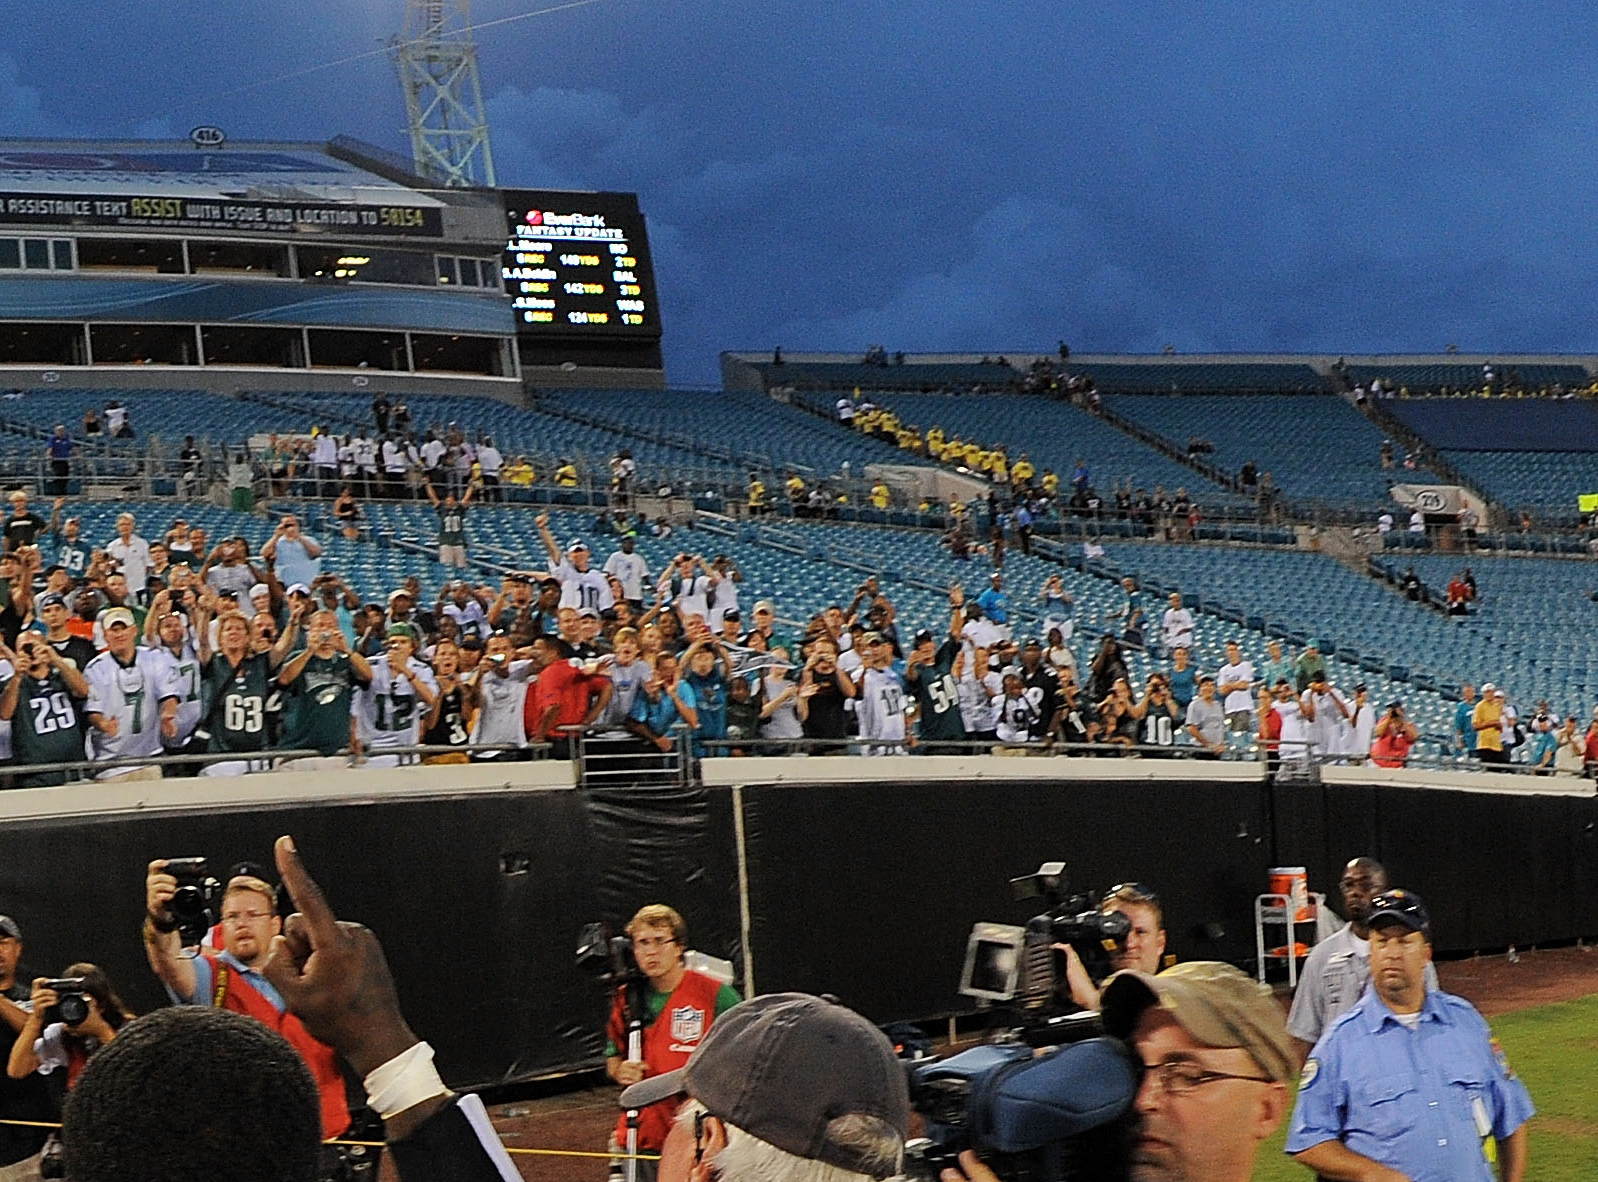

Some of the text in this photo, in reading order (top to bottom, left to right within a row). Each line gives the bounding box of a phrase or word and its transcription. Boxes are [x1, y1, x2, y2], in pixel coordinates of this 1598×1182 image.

[8, 200, 92, 215] ASSISTANCE
[96, 201, 127, 216] TEXT
[131, 199, 182, 217] ASSIST
[186, 204, 221, 219] WITH
[224, 206, 263, 221] ISSUE
[266, 208, 293, 222] AND
[296, 209, 358, 225] LOCATION
[361, 211, 378, 225] TO
[542, 211, 606, 227] EverBank
[516, 225, 623, 238] FANTASY UPDATE
[927, 674, 960, 714] 54
[30, 692, 76, 736] 29
[224, 693, 264, 734] 63
[1146, 715, 1173, 746] 10
